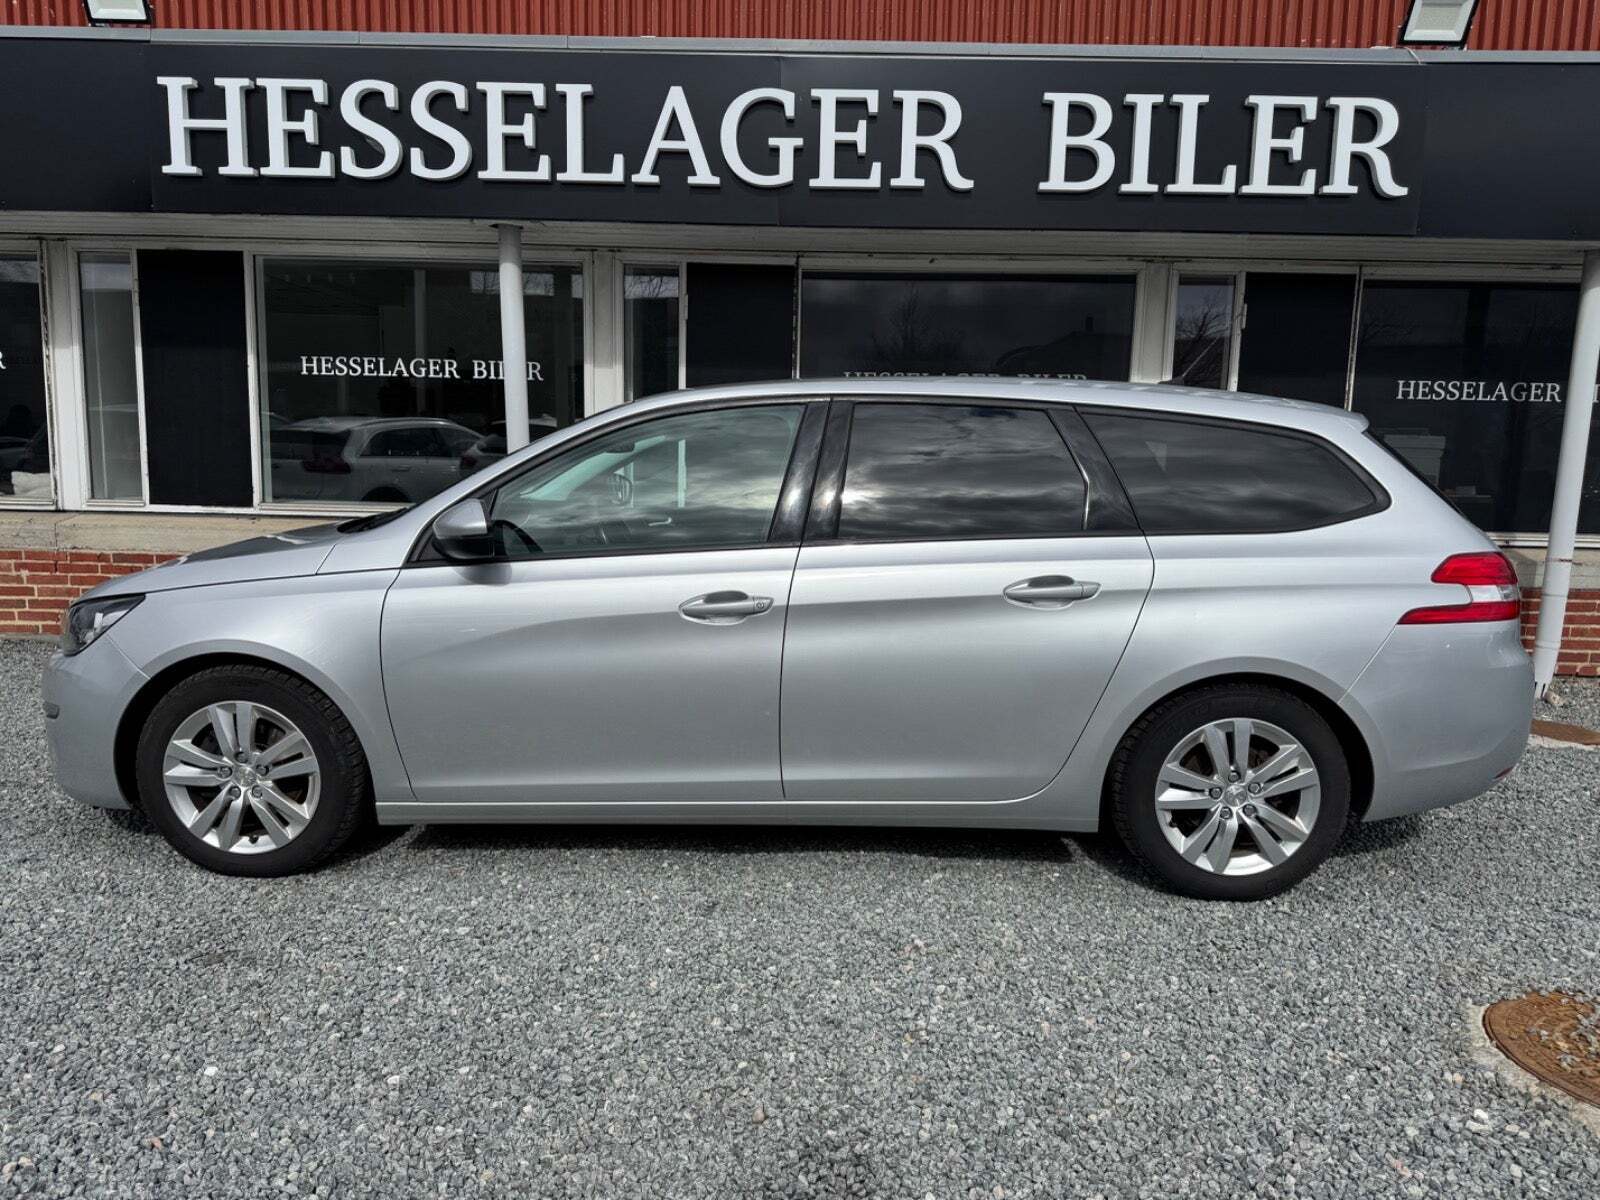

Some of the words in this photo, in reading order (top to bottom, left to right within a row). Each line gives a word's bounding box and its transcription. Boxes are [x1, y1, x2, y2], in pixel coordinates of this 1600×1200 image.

[156, 75, 975, 191] HESSELAGER
[1037, 91, 1409, 198] BILER
[300, 355, 461, 379] HESSELAGER
[472, 359, 544, 381] BILR
[1395, 379, 1562, 403] HESSELAGER
